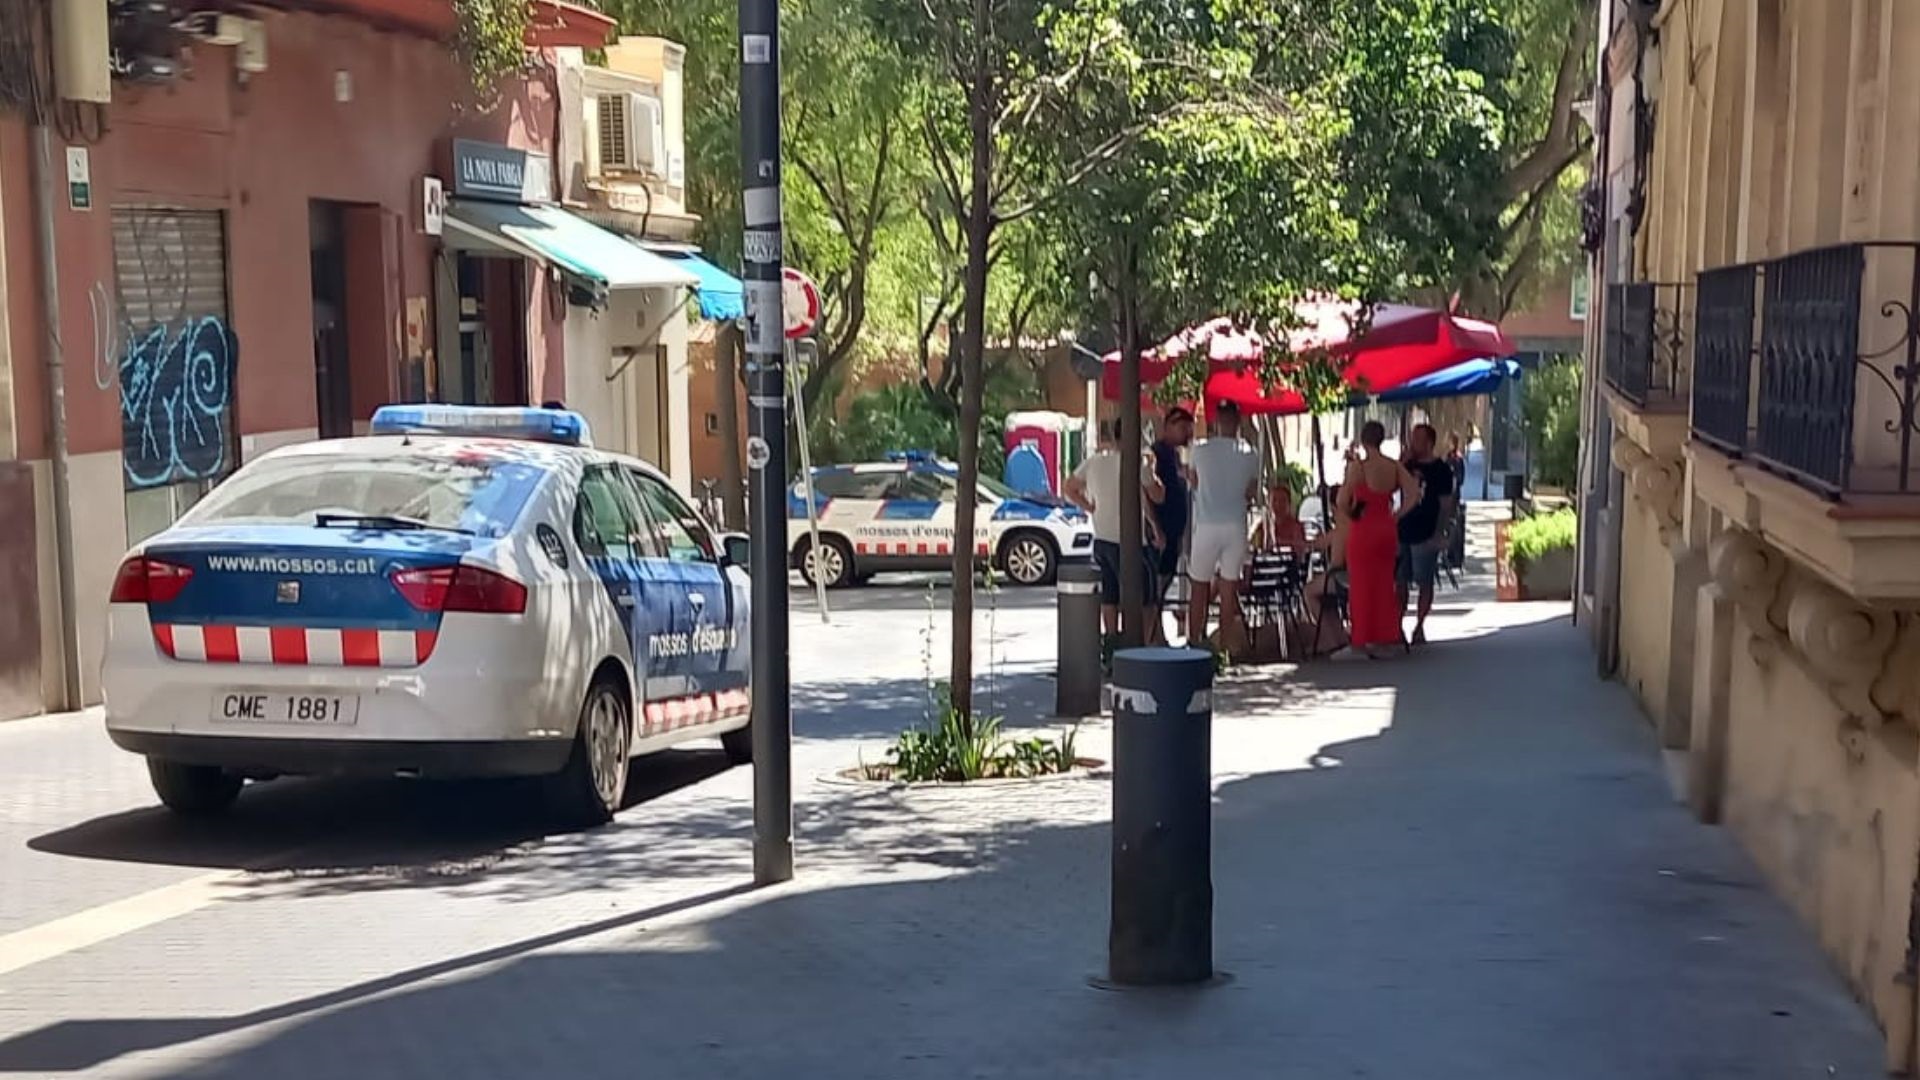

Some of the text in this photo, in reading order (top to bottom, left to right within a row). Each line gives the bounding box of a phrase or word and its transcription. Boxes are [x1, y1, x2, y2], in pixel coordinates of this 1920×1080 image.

[462, 155, 474, 181] LA
[856, 525, 909, 537] mossos
[207, 554, 377, 574] www.mossos.cat
[648, 631, 687, 658] mossos
[223, 694, 340, 721] CME 1881
